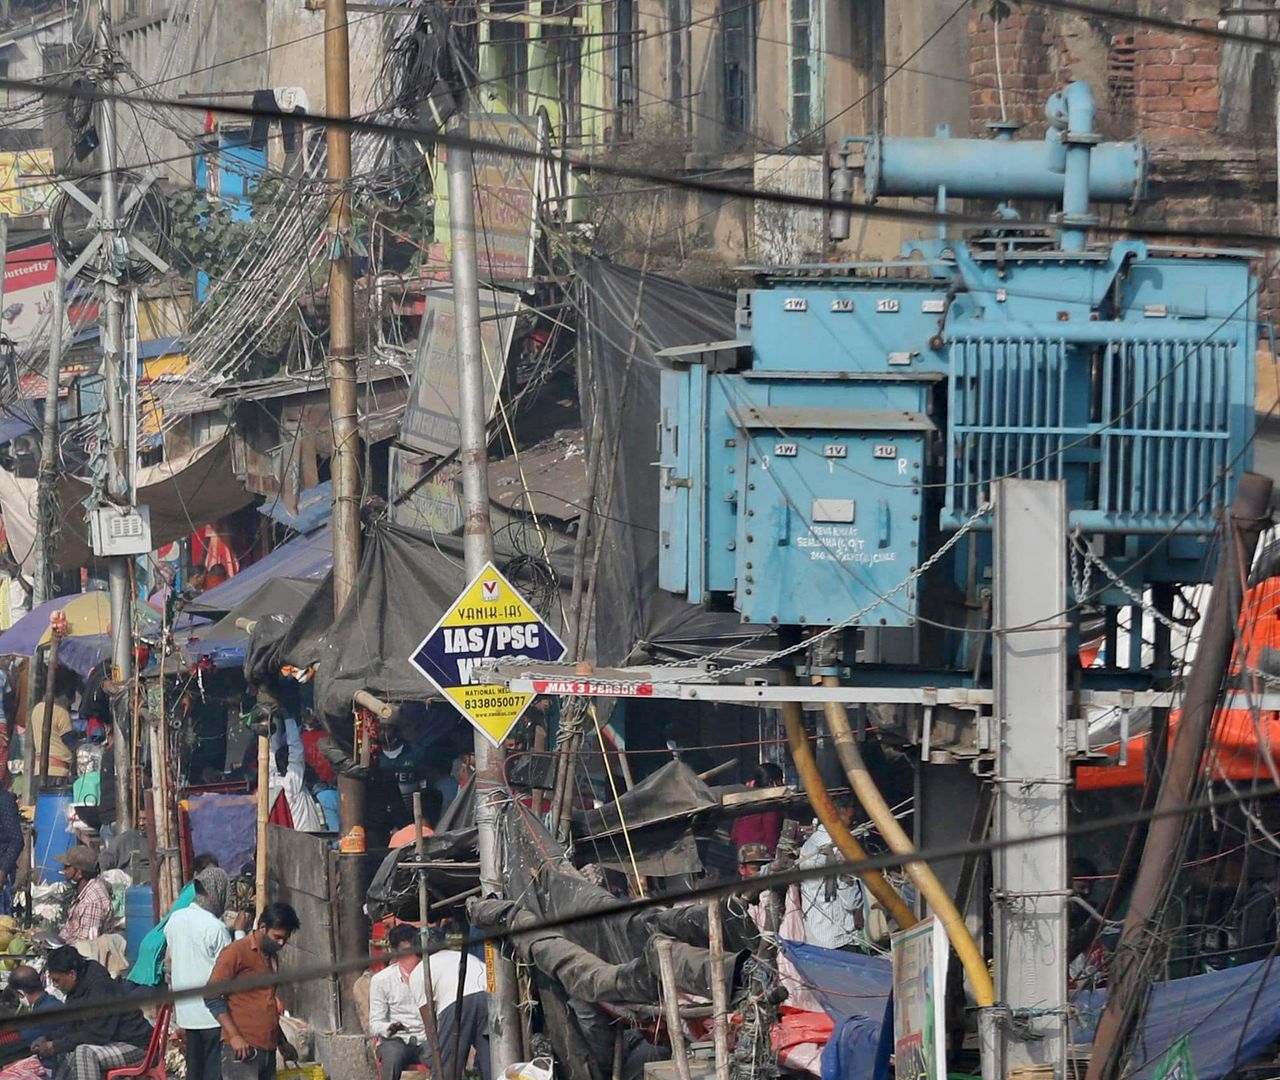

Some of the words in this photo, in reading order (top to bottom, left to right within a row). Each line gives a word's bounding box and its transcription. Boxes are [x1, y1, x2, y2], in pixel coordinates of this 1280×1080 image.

[787, 300, 803, 308] 1W
[777, 444, 794, 455] 1W
[827, 445, 844, 456] 1V
[458, 604, 522, 621] VANIK-IAS
[443, 624, 540, 656] IAS/PSC
[465, 689, 495, 697] NATIONAL
[548, 682, 574, 693] MAX
[576, 682, 586, 693] 3
[590, 684, 638, 695] PERSON
[464, 696, 526, 711] 8338050077
